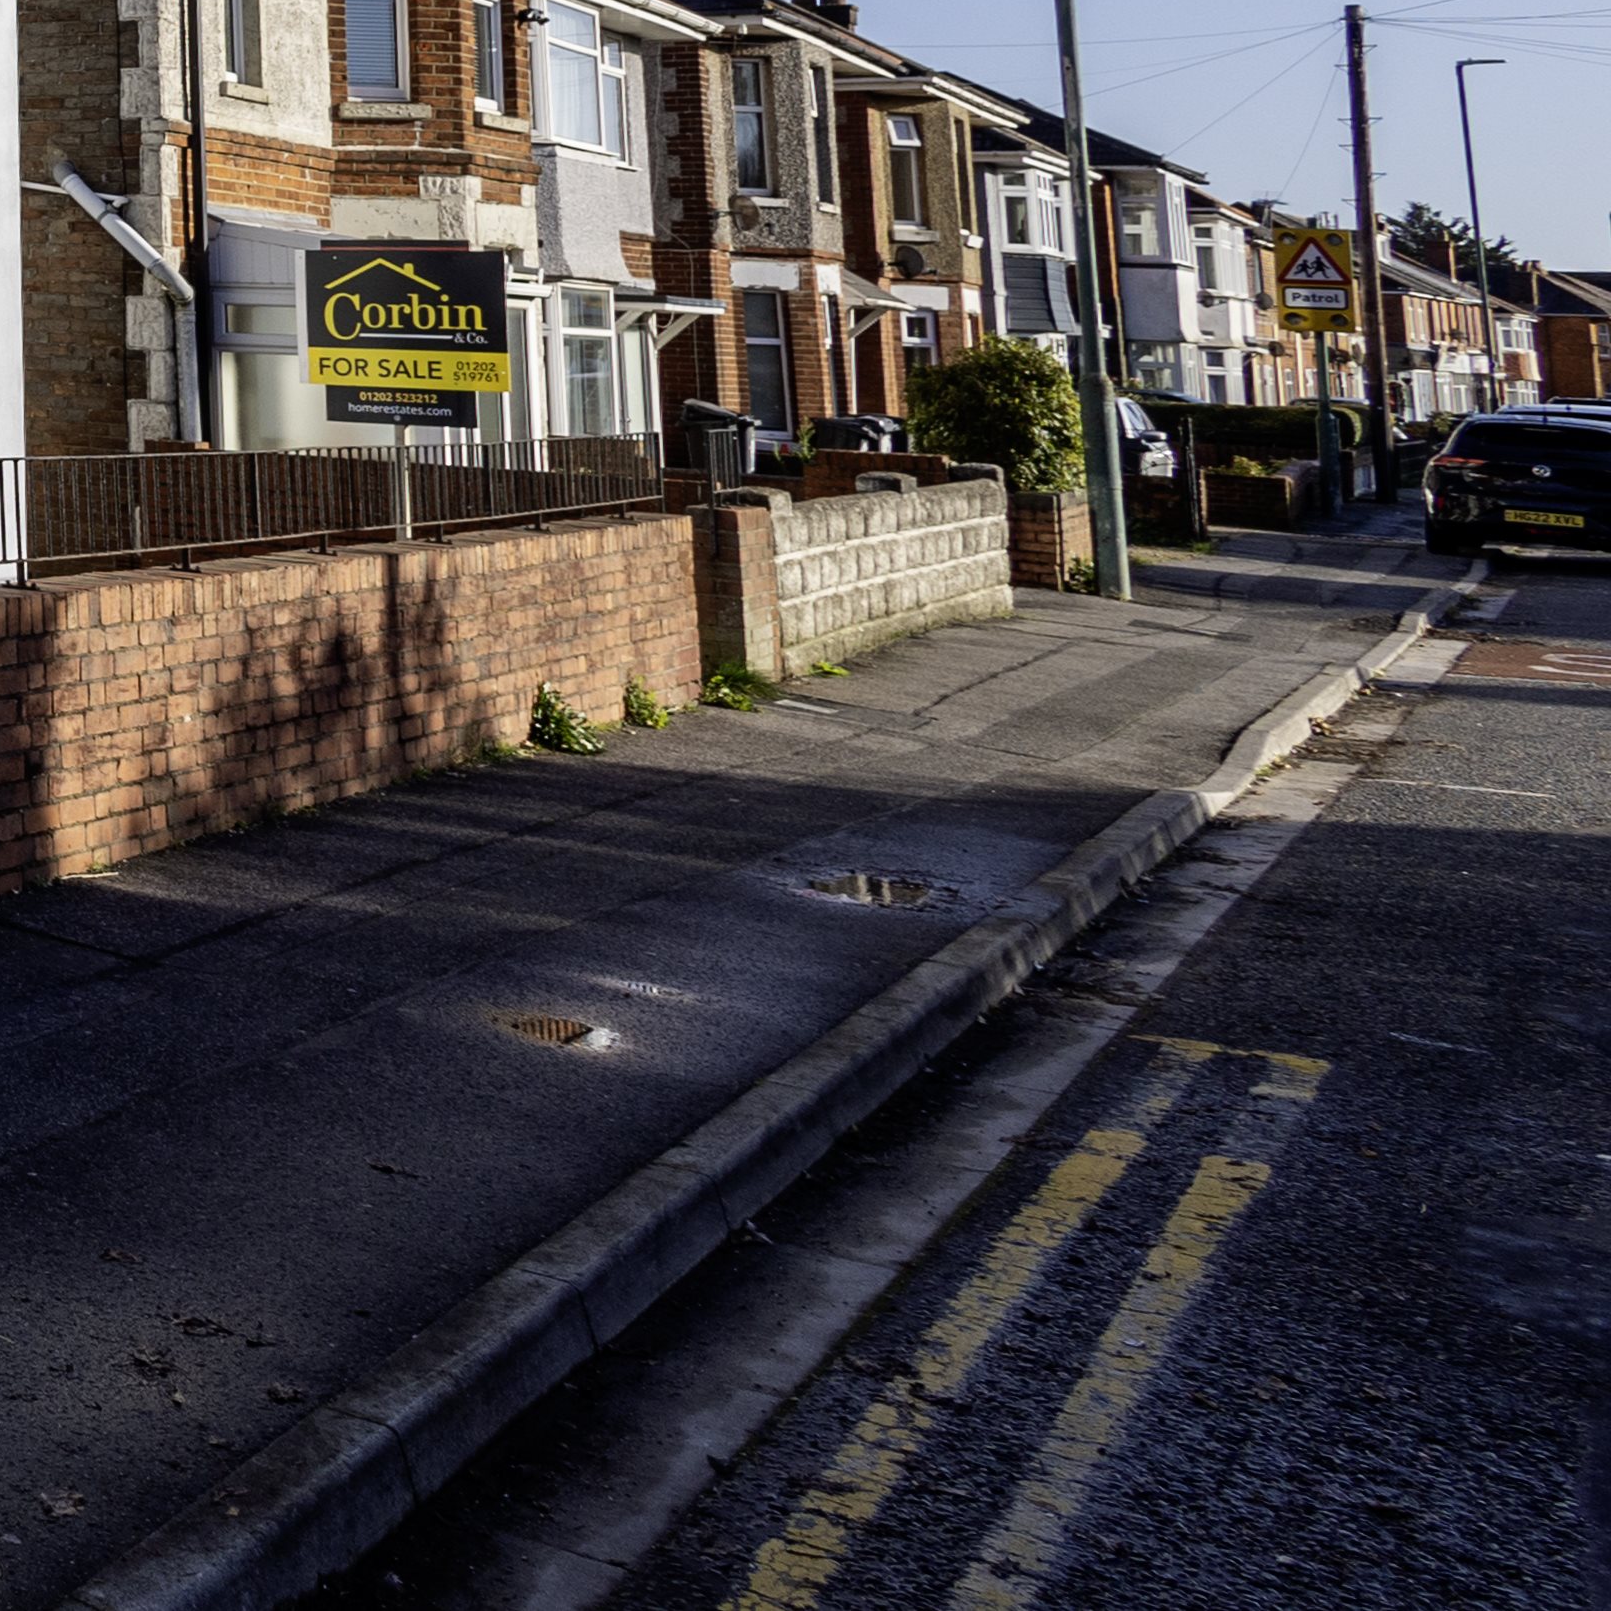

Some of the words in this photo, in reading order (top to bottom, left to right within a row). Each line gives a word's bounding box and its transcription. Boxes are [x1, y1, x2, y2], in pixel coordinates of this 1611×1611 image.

[1292, 292, 1340, 304] Patrol
[324, 292, 488, 341] Corbin
[454, 332, 465, 344] &
[466, 332, 489, 344] Co.
[318, 357, 368, 377] FOR
[378, 358, 443, 380] SALE
[456, 361, 496, 372] 01202
[453, 371, 500, 383] 519761
[359, 390, 393, 402] 01202
[395, 393, 438, 404] 523212
[347, 402, 453, 417] homerestates.com
